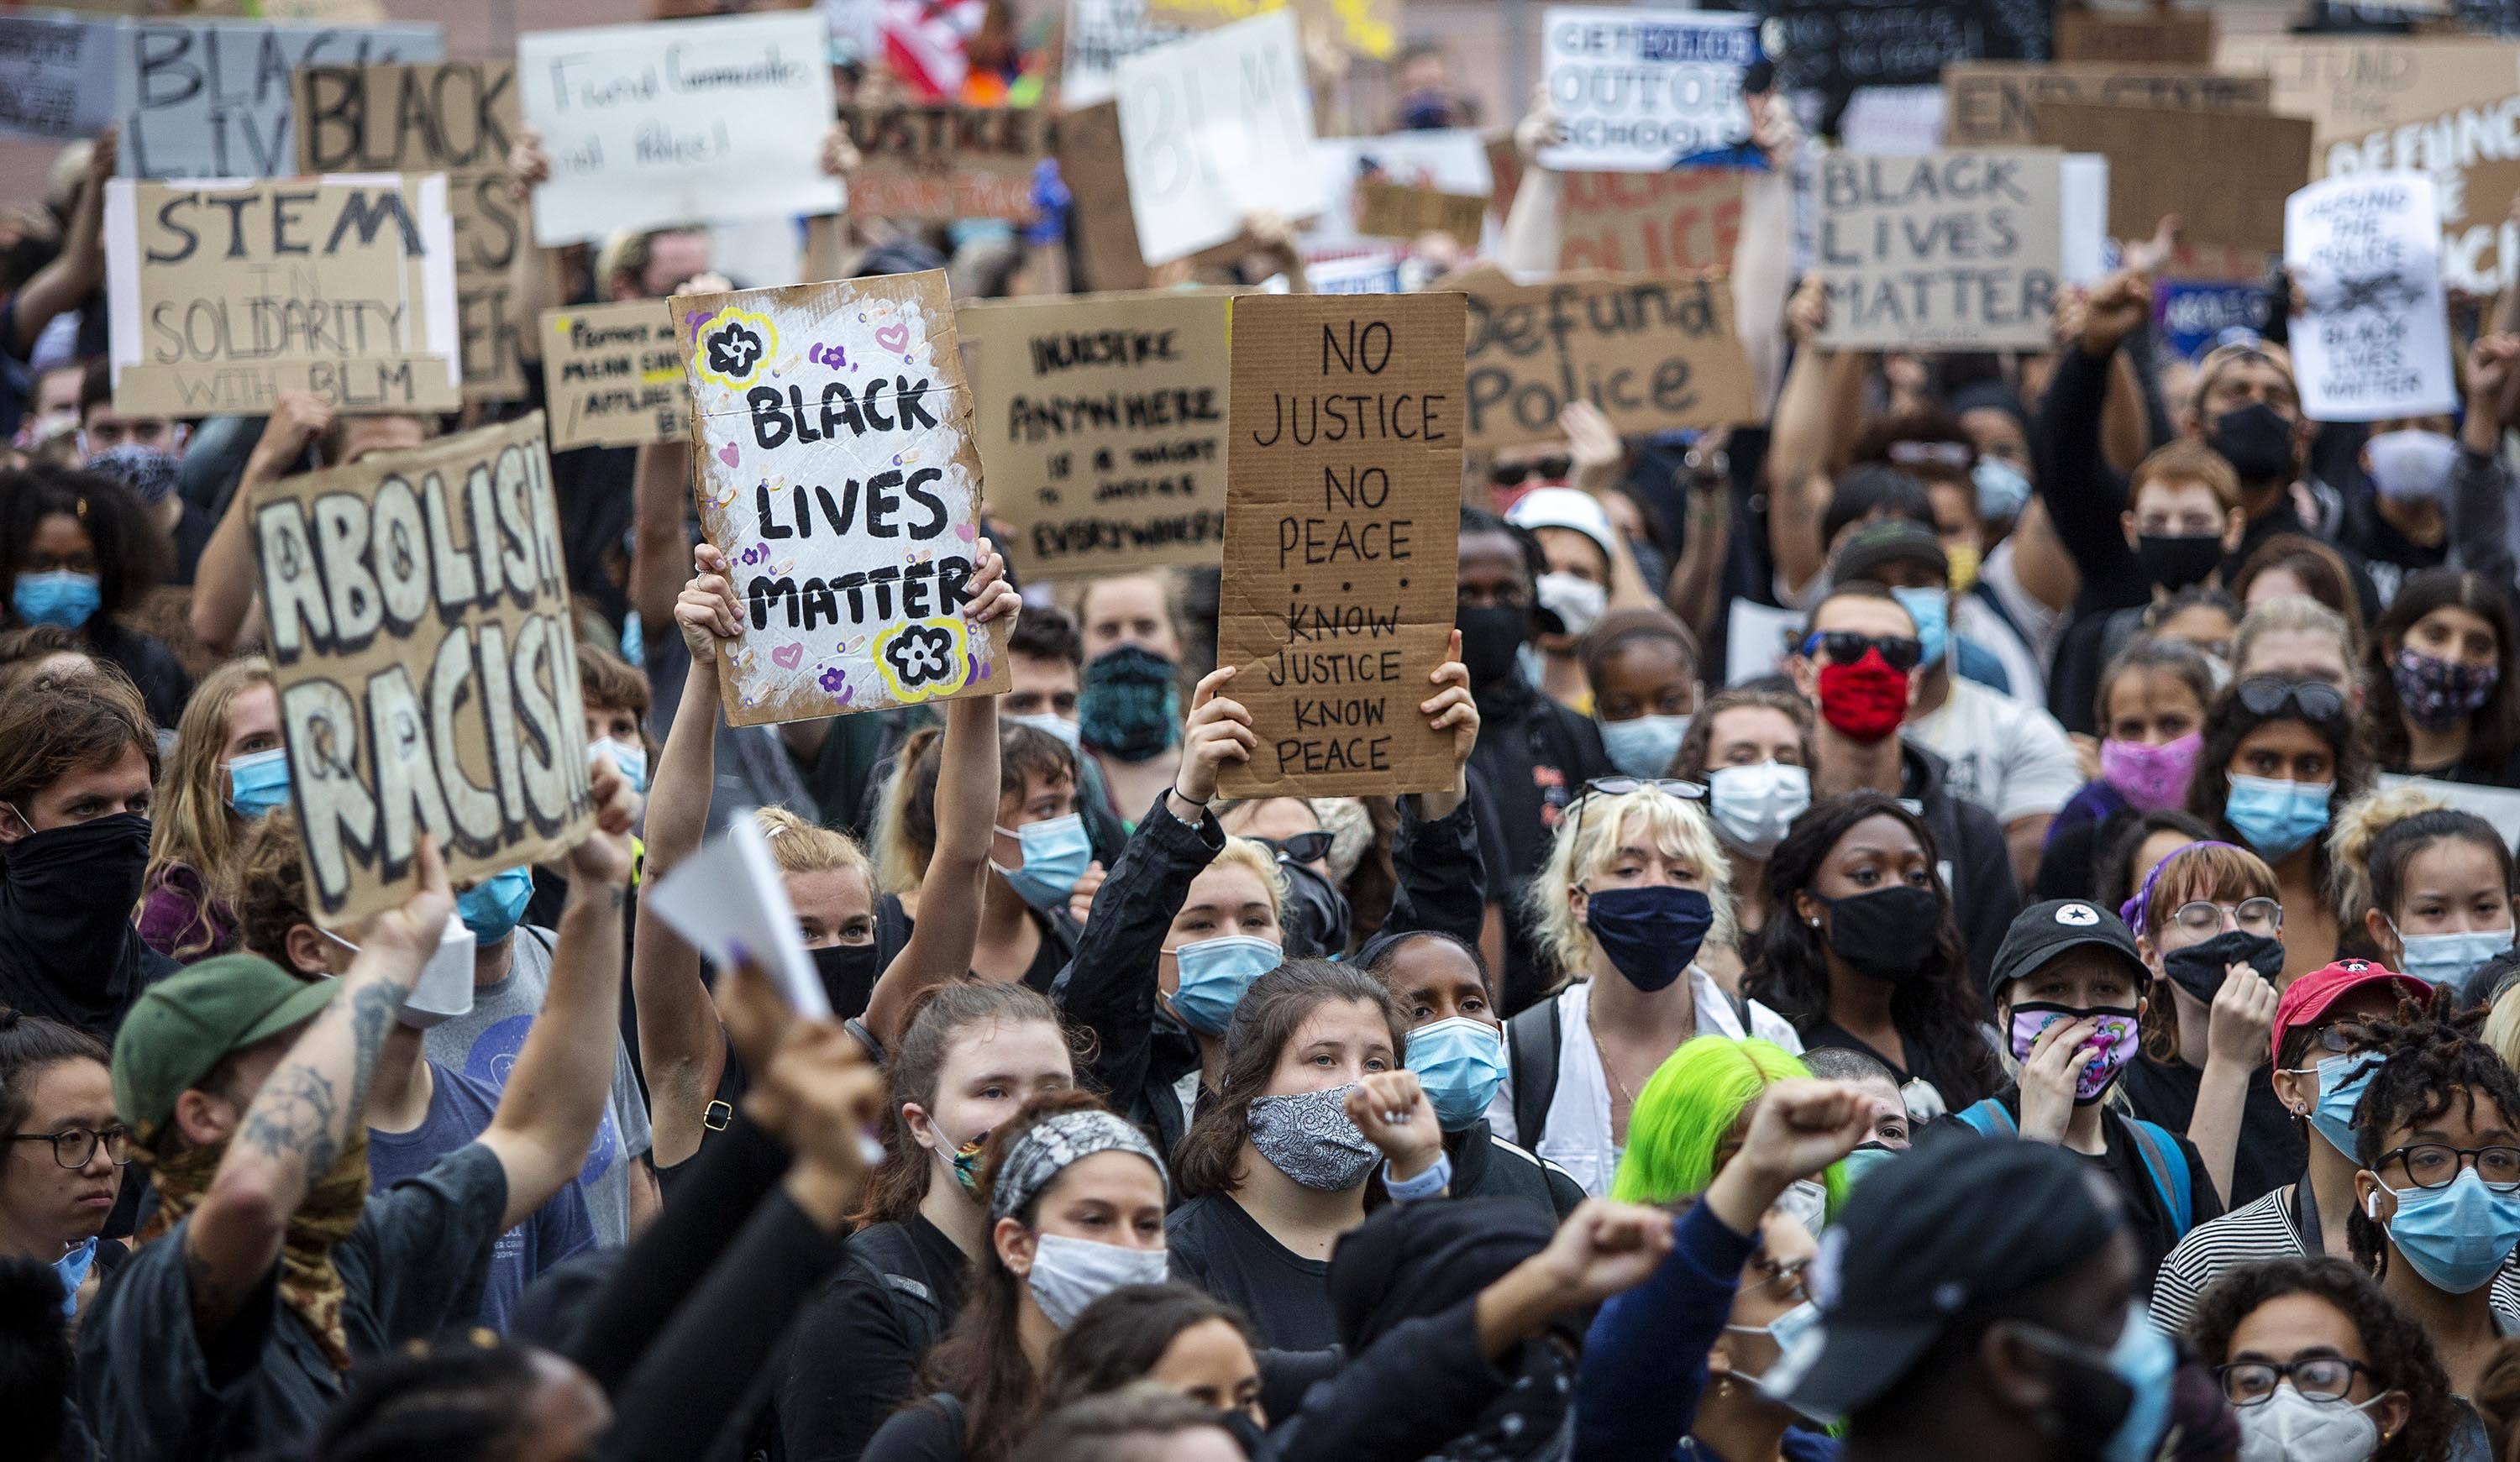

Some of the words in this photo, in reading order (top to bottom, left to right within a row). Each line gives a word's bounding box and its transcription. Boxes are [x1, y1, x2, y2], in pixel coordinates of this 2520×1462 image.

[306, 62, 512, 170] BLACK
[1551, 65, 1667, 115] OUT
[129, 111, 291, 179] LIV
[1127, 42, 1314, 207] BLM
[1823, 155, 2028, 210] BLACK
[145, 190, 427, 265] STEM
[1821, 207, 2019, 266] LIVES
[249, 263, 323, 300] IN
[1823, 268, 2058, 329] MATTER
[151, 294, 407, 364] SOLIDARITY
[1323, 320, 1392, 376] NO
[175, 367, 279, 409] WITH
[308, 360, 415, 406] BLM
[747, 375, 939, 449] BLACK
[1468, 356, 1700, 433] Police
[1010, 385, 1221, 443] ANYWHERE
[1254, 391, 1446, 447] JUSTICE
[756, 467, 949, 540] LIVES
[1324, 465, 1389, 511] NO
[255, 435, 564, 666] ABOLISH
[1278, 516, 1413, 570] PEACE
[747, 554, 978, 631] MATTER
[1289, 600, 1401, 642] KNOW
[1268, 649, 1403, 687] JUSTICE
[1294, 696, 1386, 731] KNOW
[281, 609, 590, 910] RACISM
[1276, 734, 1392, 773] PEACE
